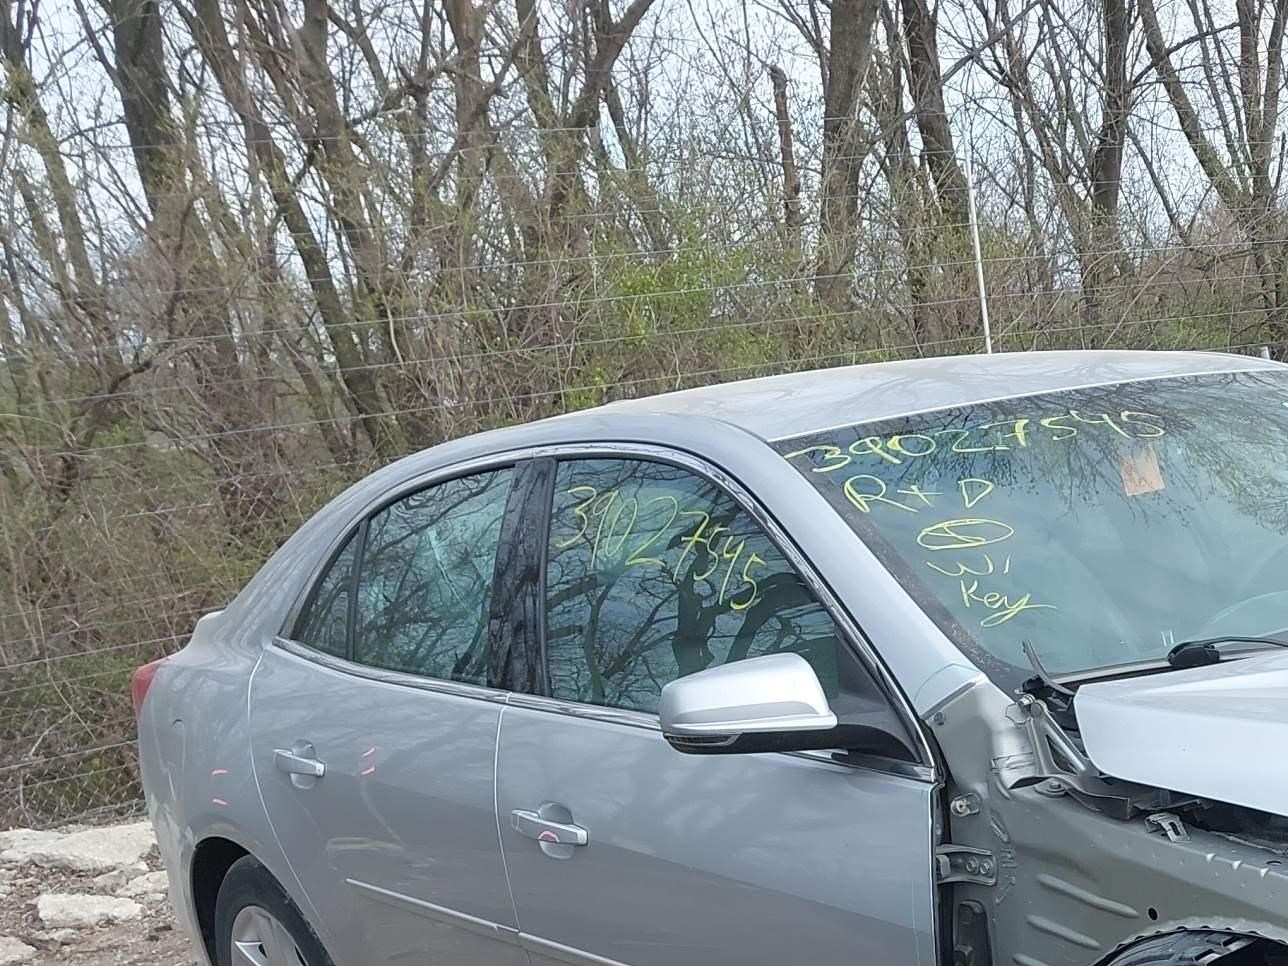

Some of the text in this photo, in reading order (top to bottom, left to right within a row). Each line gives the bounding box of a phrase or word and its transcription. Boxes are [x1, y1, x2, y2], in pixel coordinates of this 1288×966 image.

[783, 409, 1168, 473] 39027545
[556, 486, 767, 611] 39027545
[960, 579, 1057, 628] Key
